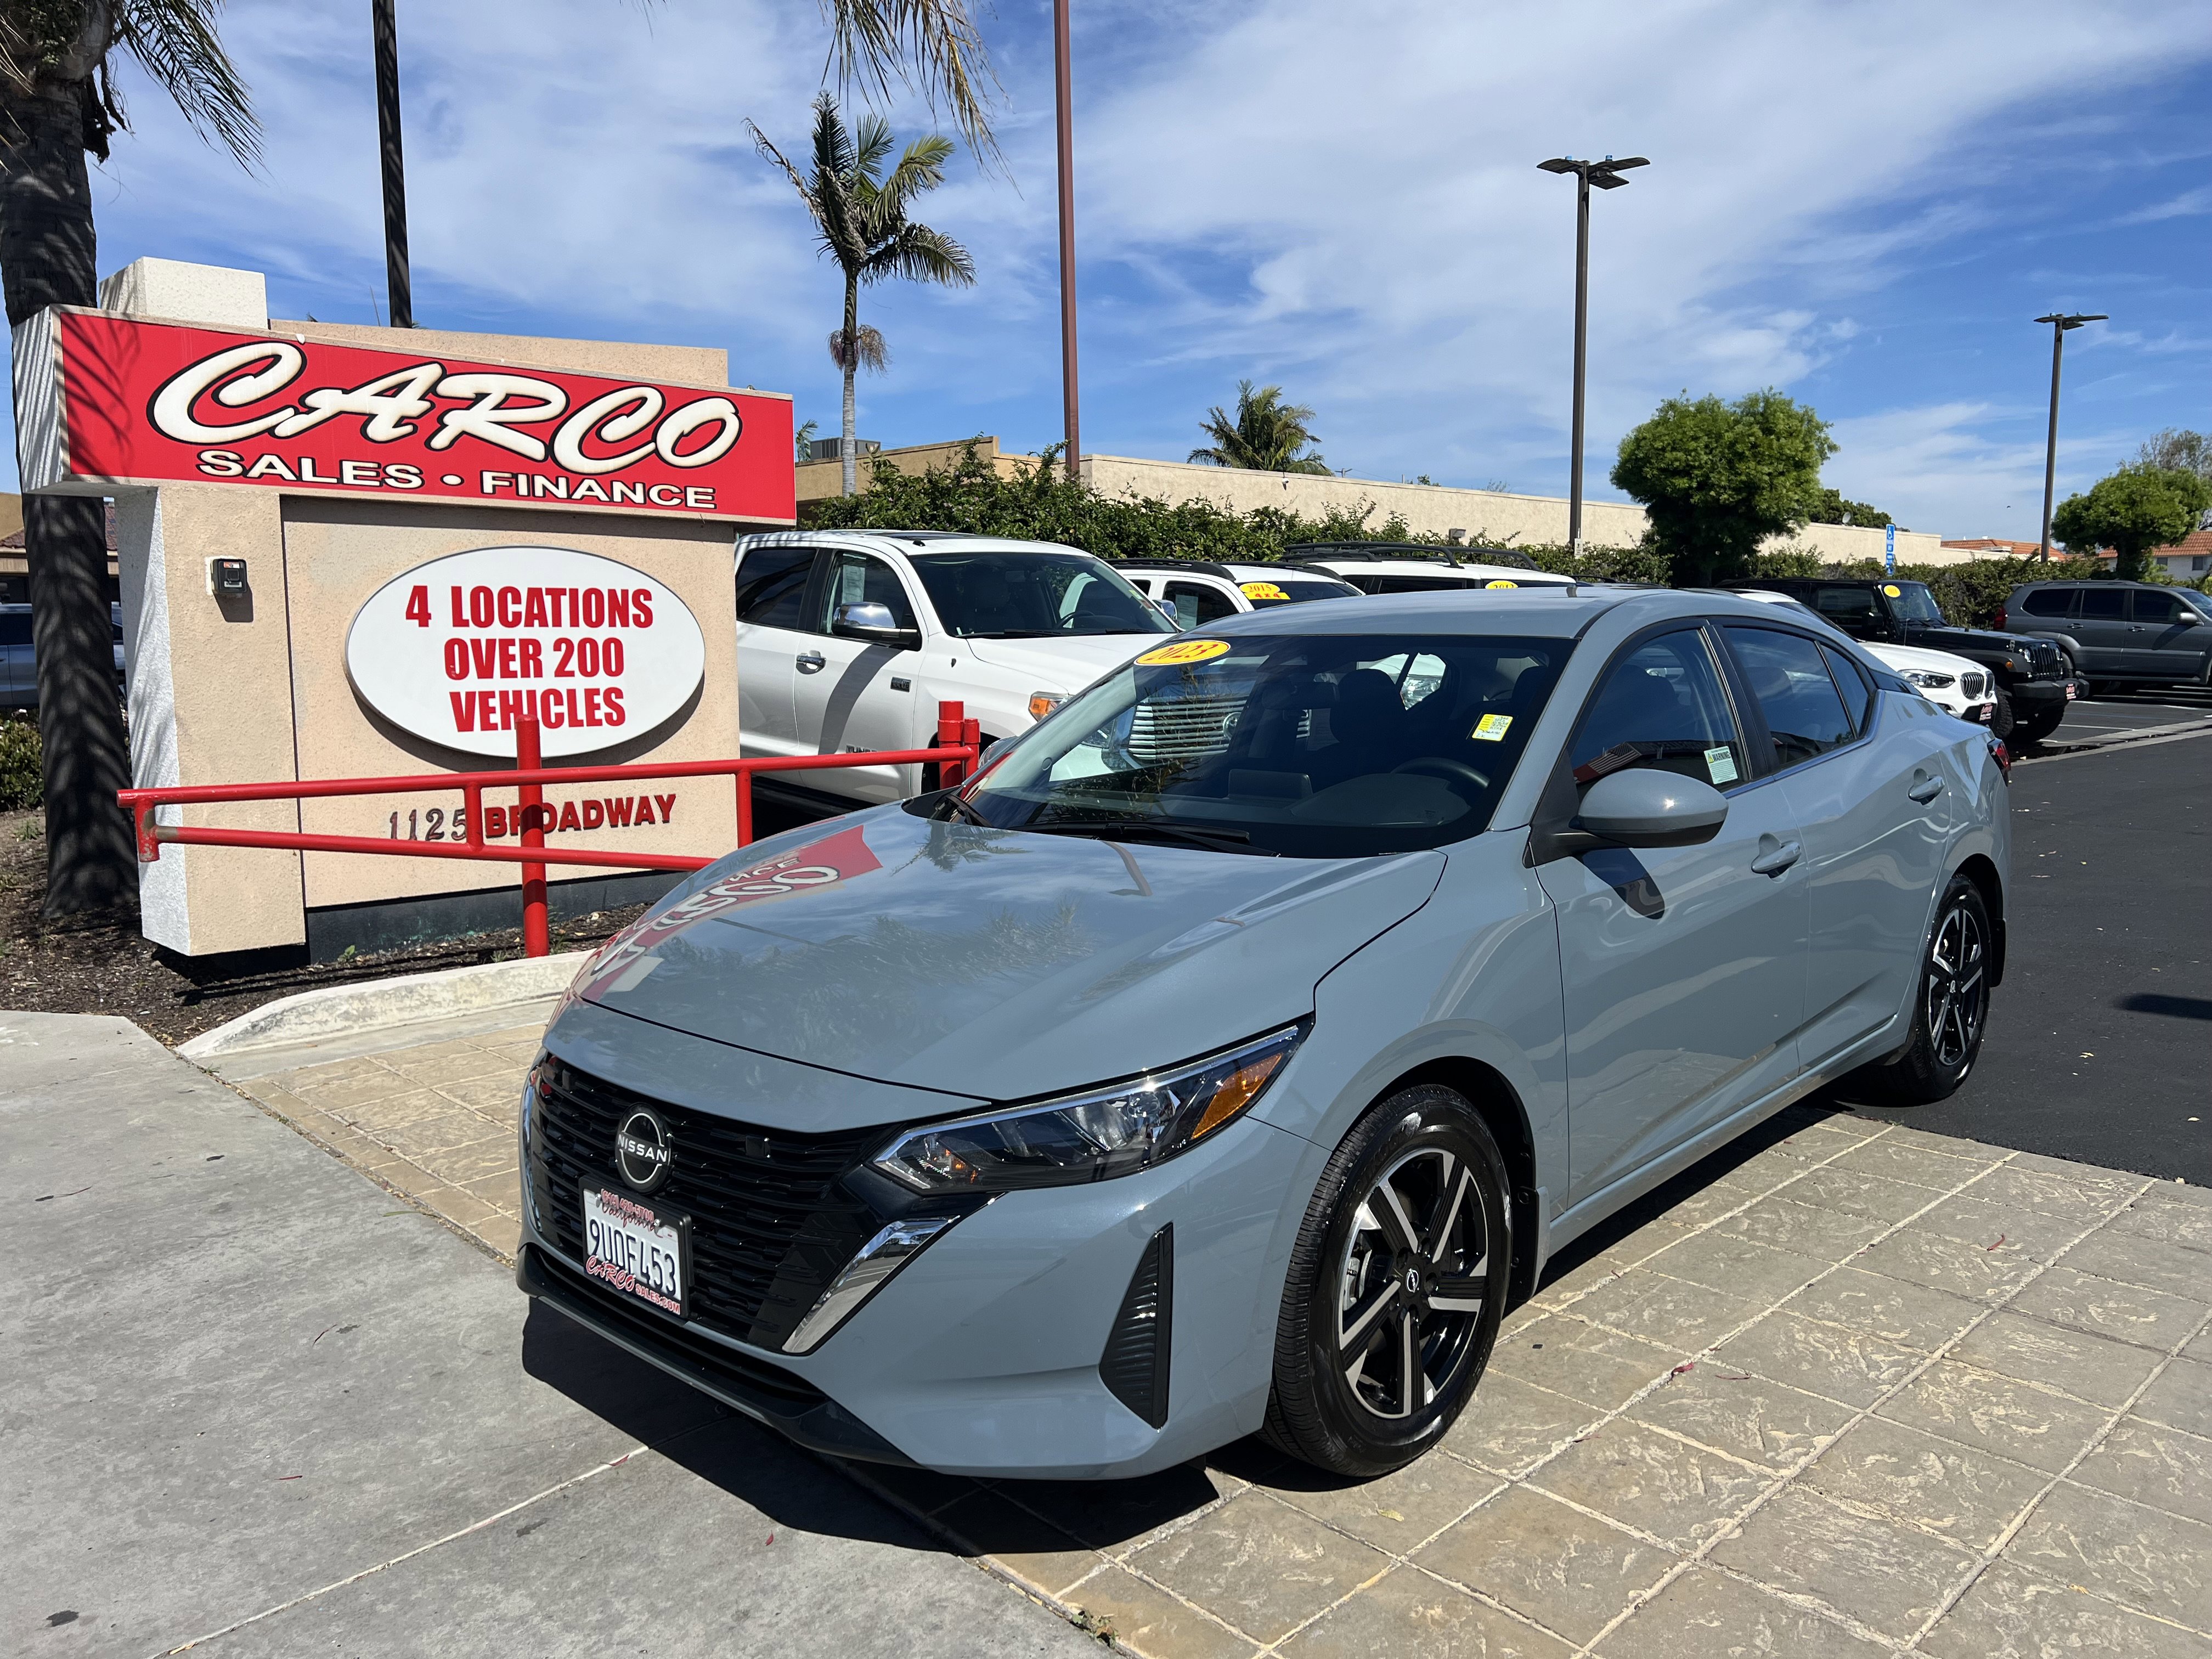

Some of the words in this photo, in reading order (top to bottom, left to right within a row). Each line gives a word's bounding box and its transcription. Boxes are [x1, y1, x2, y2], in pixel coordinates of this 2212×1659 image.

[146, 340, 742, 475] CARCO
[196, 449, 425, 489] SALES
[479, 470, 718, 509] FINANCE
[405, 585, 432, 628] 4
[451, 585, 653, 629] LOCATIONS
[444, 637, 543, 681] OVER
[552, 637, 625, 678] 200
[1143, 644, 1219, 661] 2023
[449, 686, 626, 733] VEHICLES
[389, 808, 468, 840] 1125
[617, 1133, 668, 1163] NISSAN
[585, 1254, 636, 1292] CARCO
